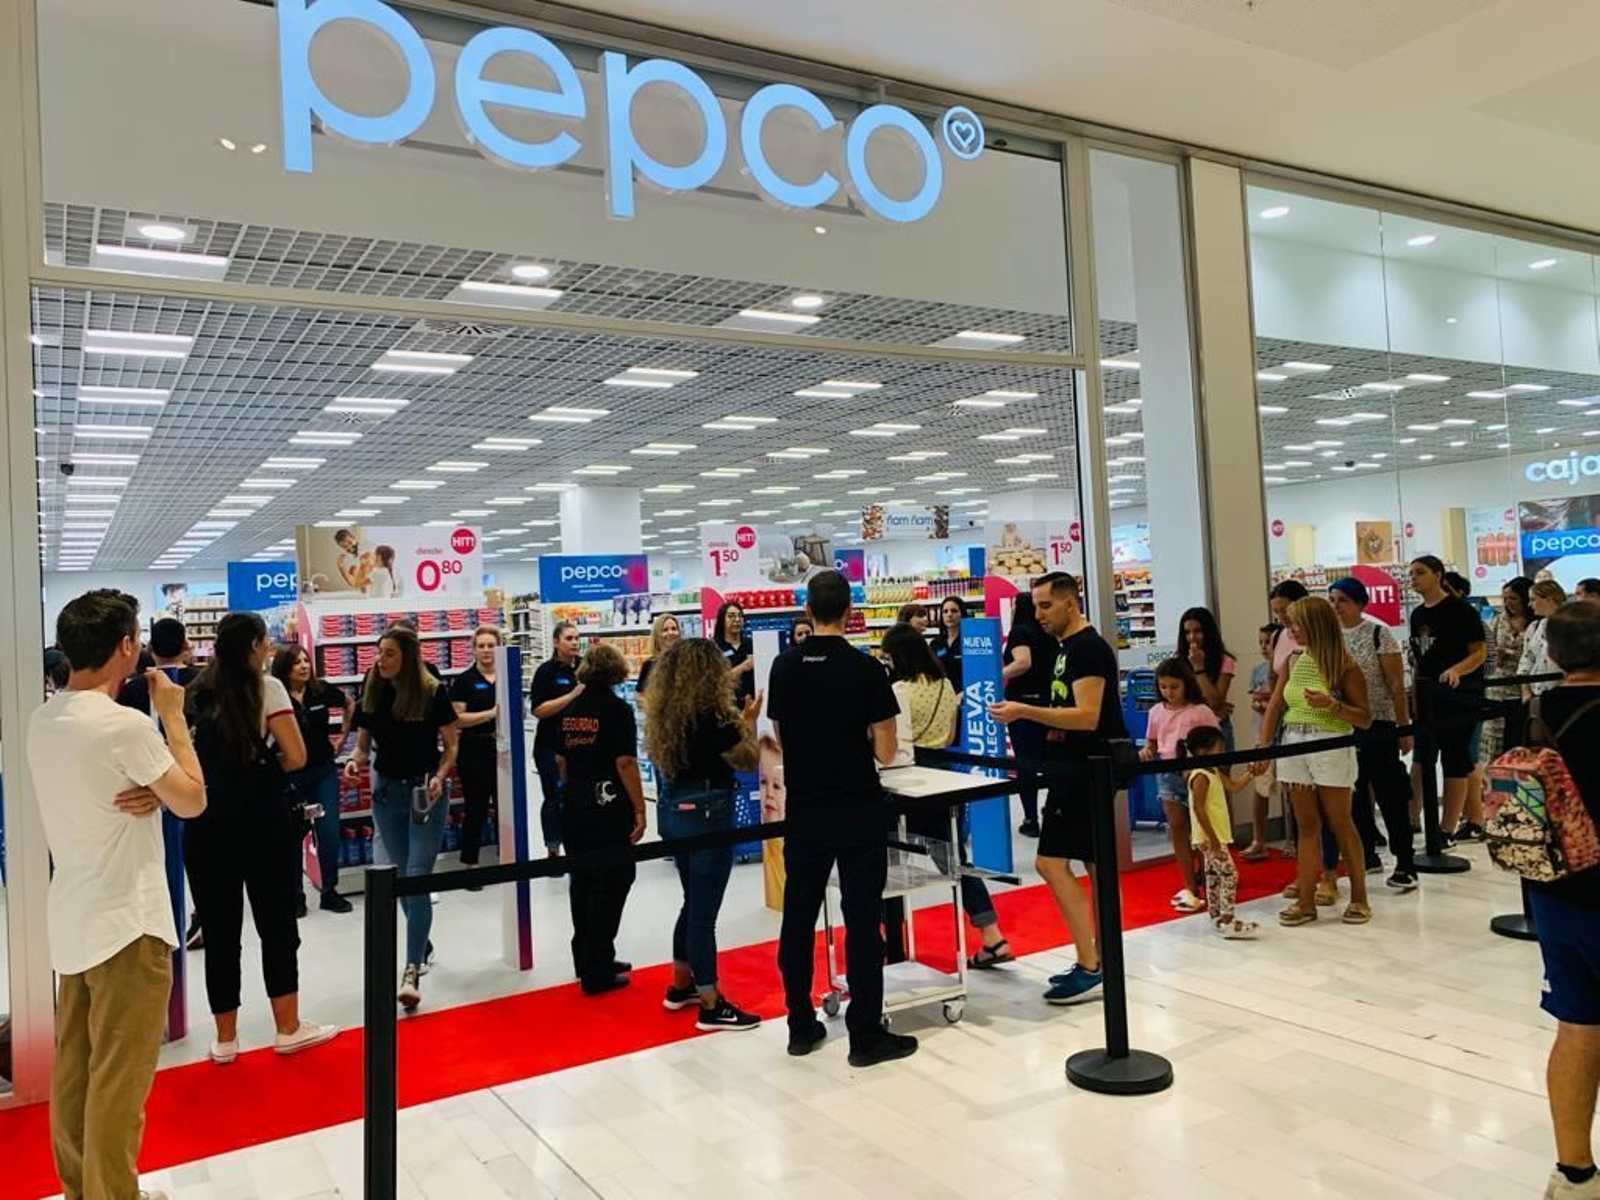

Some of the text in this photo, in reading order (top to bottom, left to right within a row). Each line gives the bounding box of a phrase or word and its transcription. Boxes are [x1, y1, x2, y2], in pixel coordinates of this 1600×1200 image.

[276, 0, 943, 221] pepco
[1532, 534, 1600, 555] pepco
[561, 565, 623, 582] pepco
[710, 550, 721, 577] 1
[416, 560, 441, 591] 0
[1367, 585, 1394, 604] IT!
[963, 636, 993, 648] NUEVA
